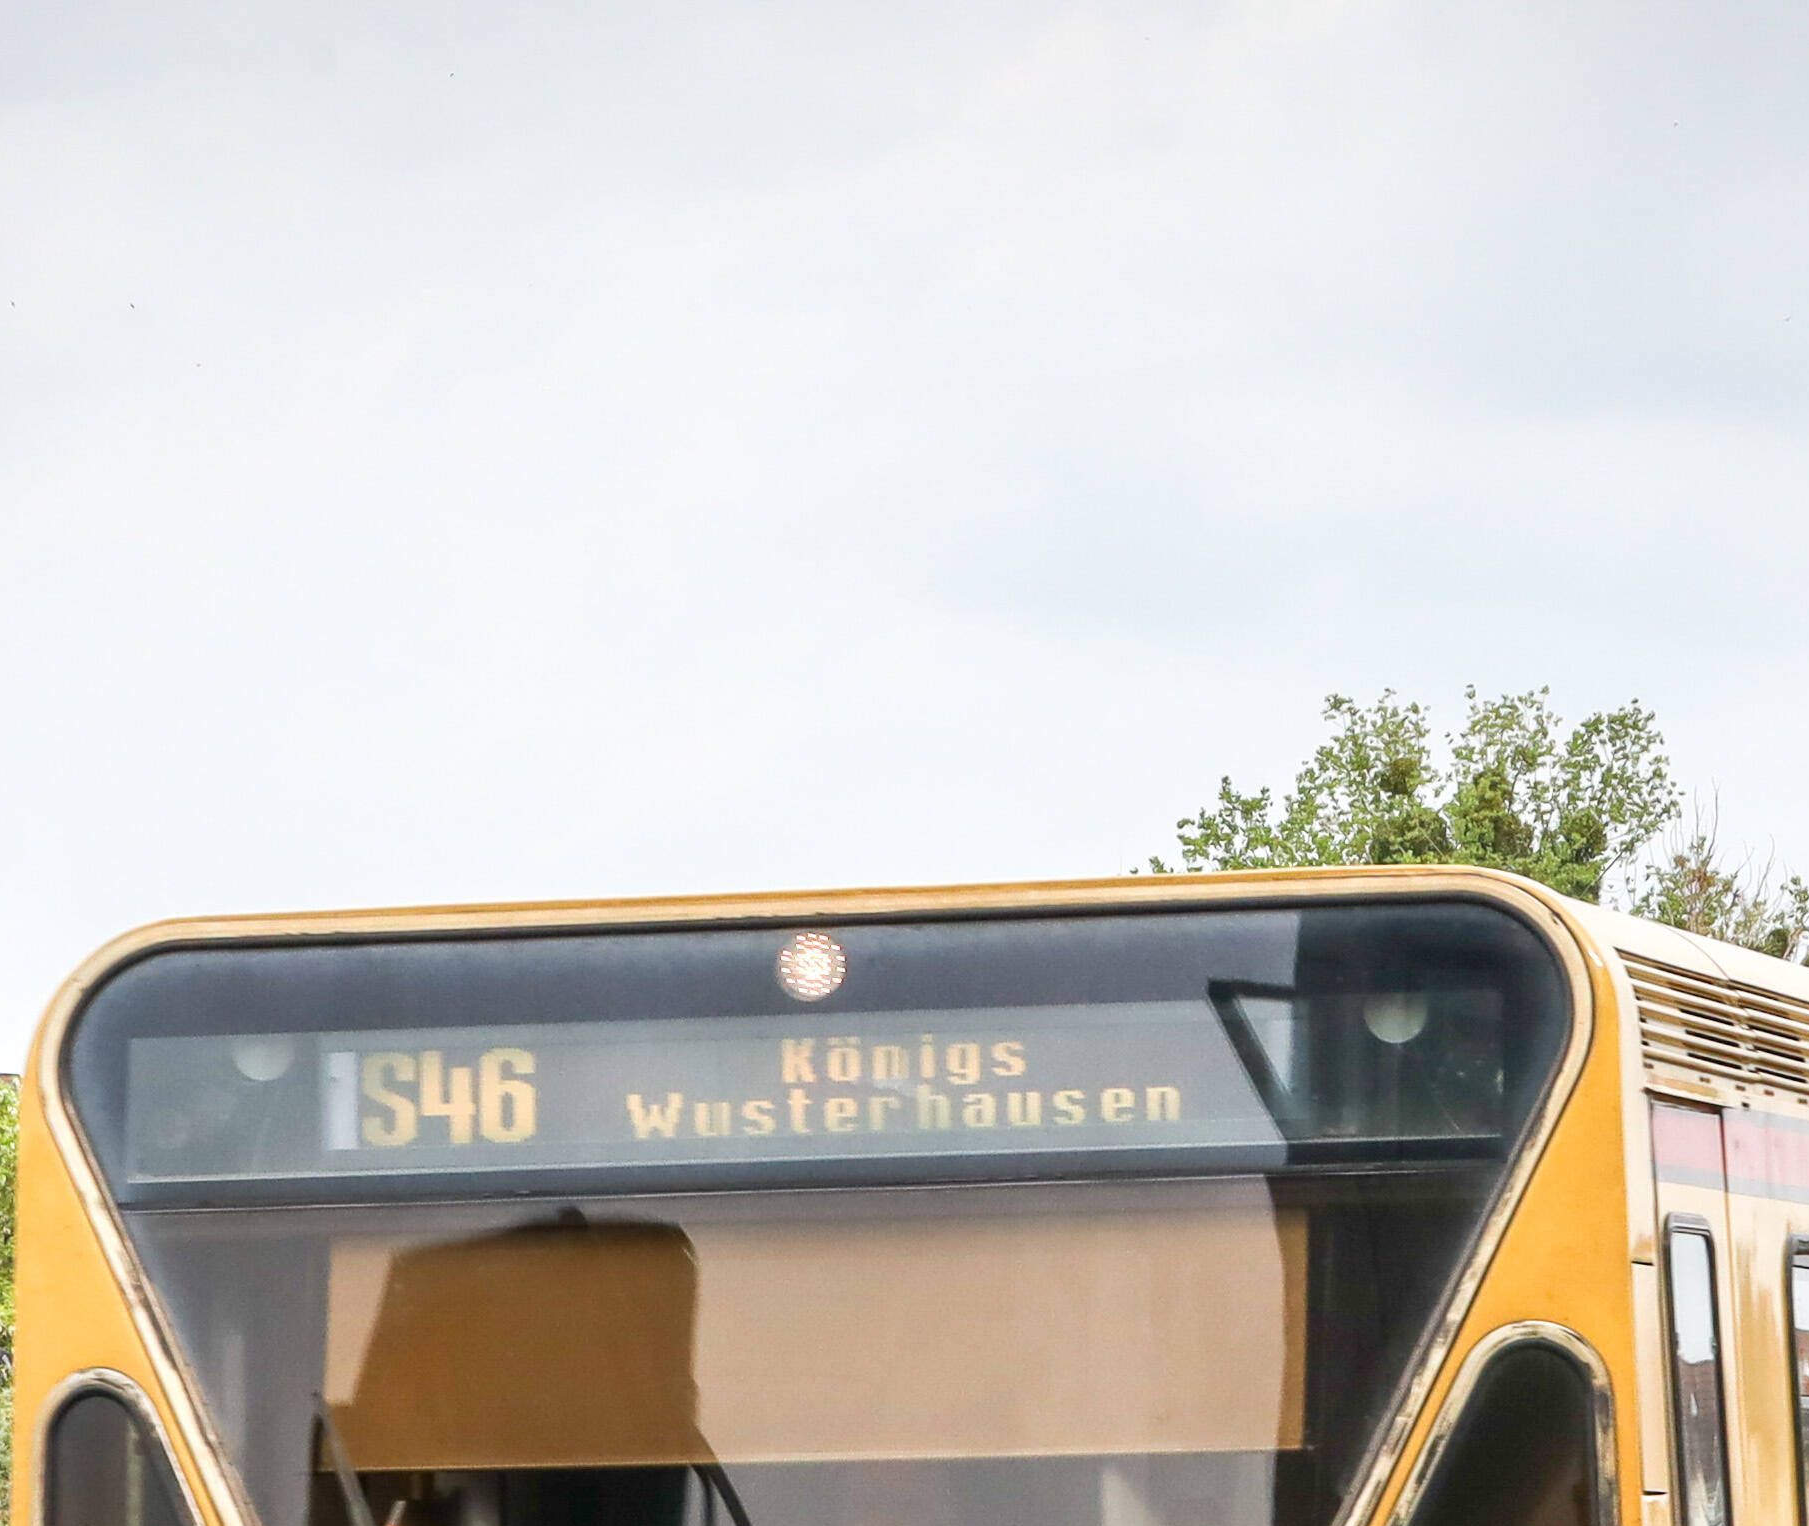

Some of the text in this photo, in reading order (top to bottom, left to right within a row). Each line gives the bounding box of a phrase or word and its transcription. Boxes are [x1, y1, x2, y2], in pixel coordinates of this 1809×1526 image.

[779, 1033, 1029, 1086] Königs
[360, 1046, 537, 1148] S46
[625, 1083, 1183, 1140] Wusterhausen
